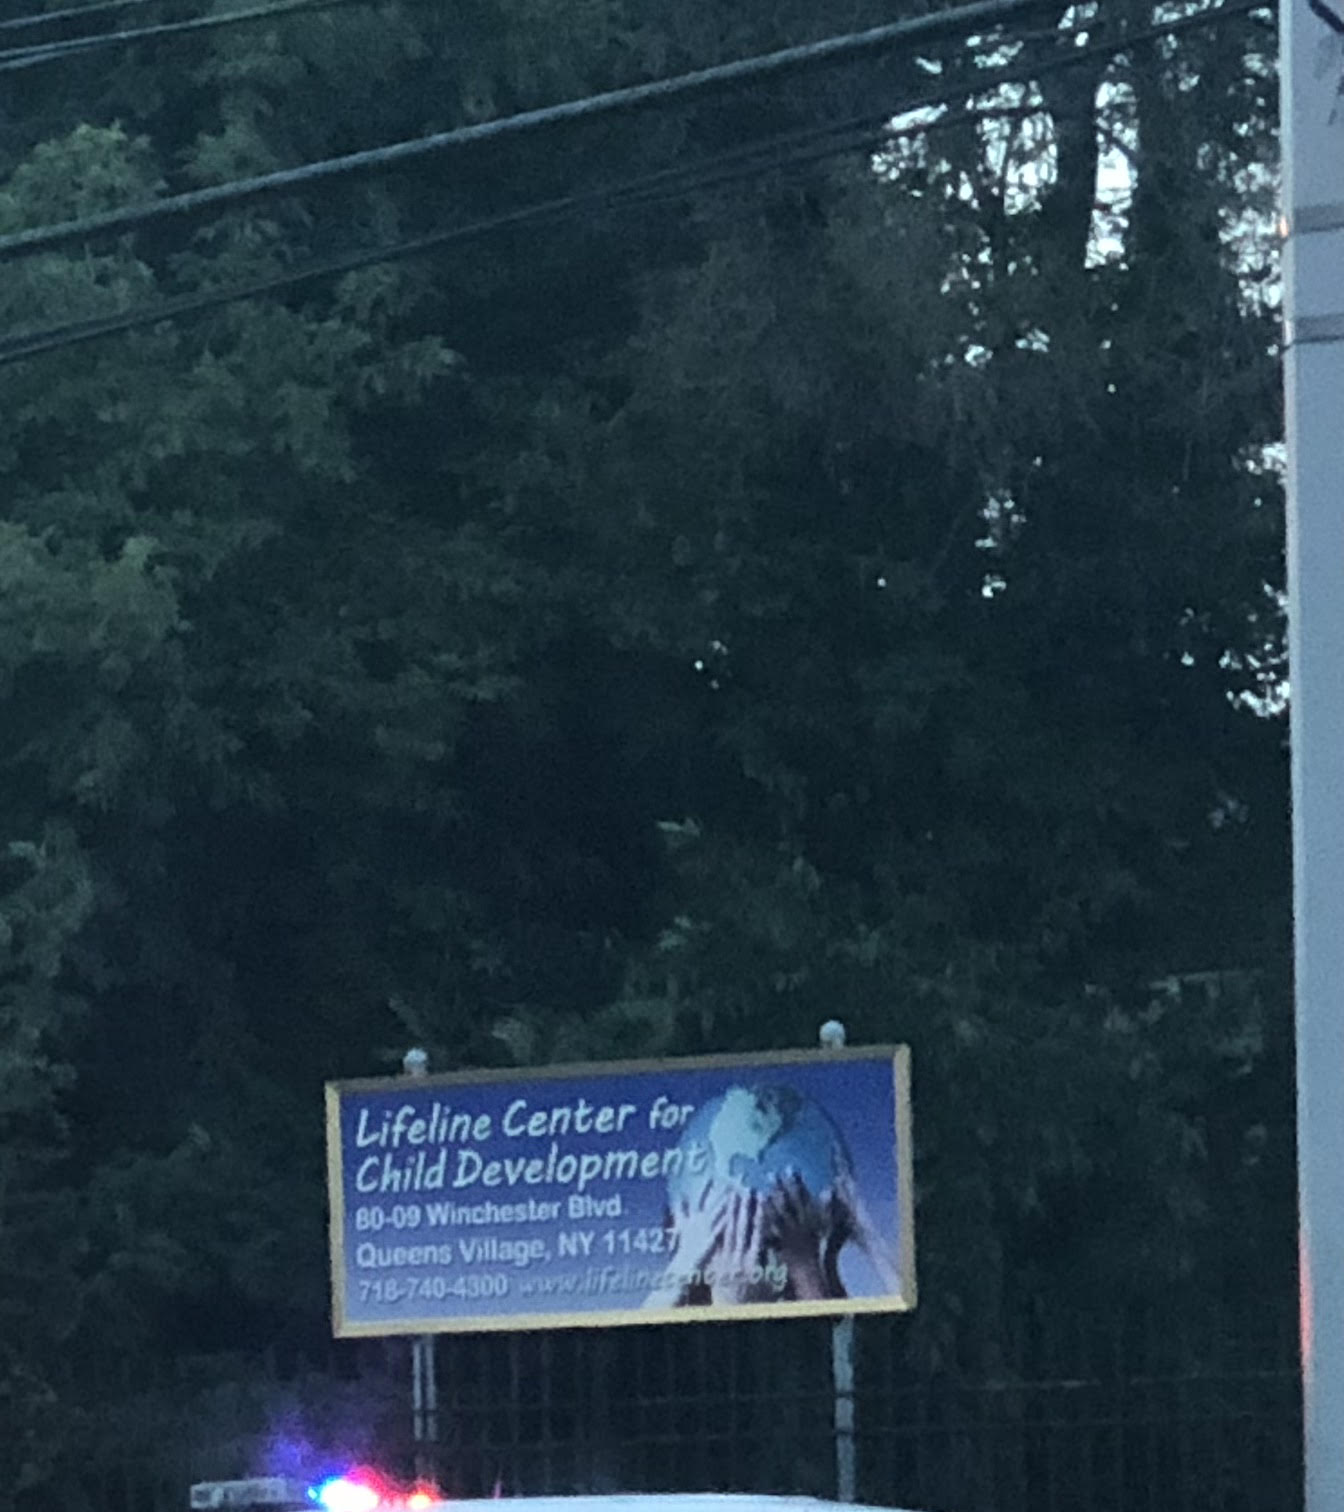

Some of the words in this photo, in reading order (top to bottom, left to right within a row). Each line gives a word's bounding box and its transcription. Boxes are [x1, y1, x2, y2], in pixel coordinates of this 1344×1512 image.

[356, 1102, 491, 1148] Lifeline
[503, 1098, 636, 1138] Center
[649, 1096, 695, 1130] for
[355, 1147, 448, 1193] Child
[453, 1141, 709, 1191] Development
[355, 1204, 421, 1231] 80-09
[426, 1197, 560, 1227] Winchester
[356, 1242, 453, 1269] Queens
[459, 1235, 551, 1267] Village,
[558, 1230, 595, 1257] NY
